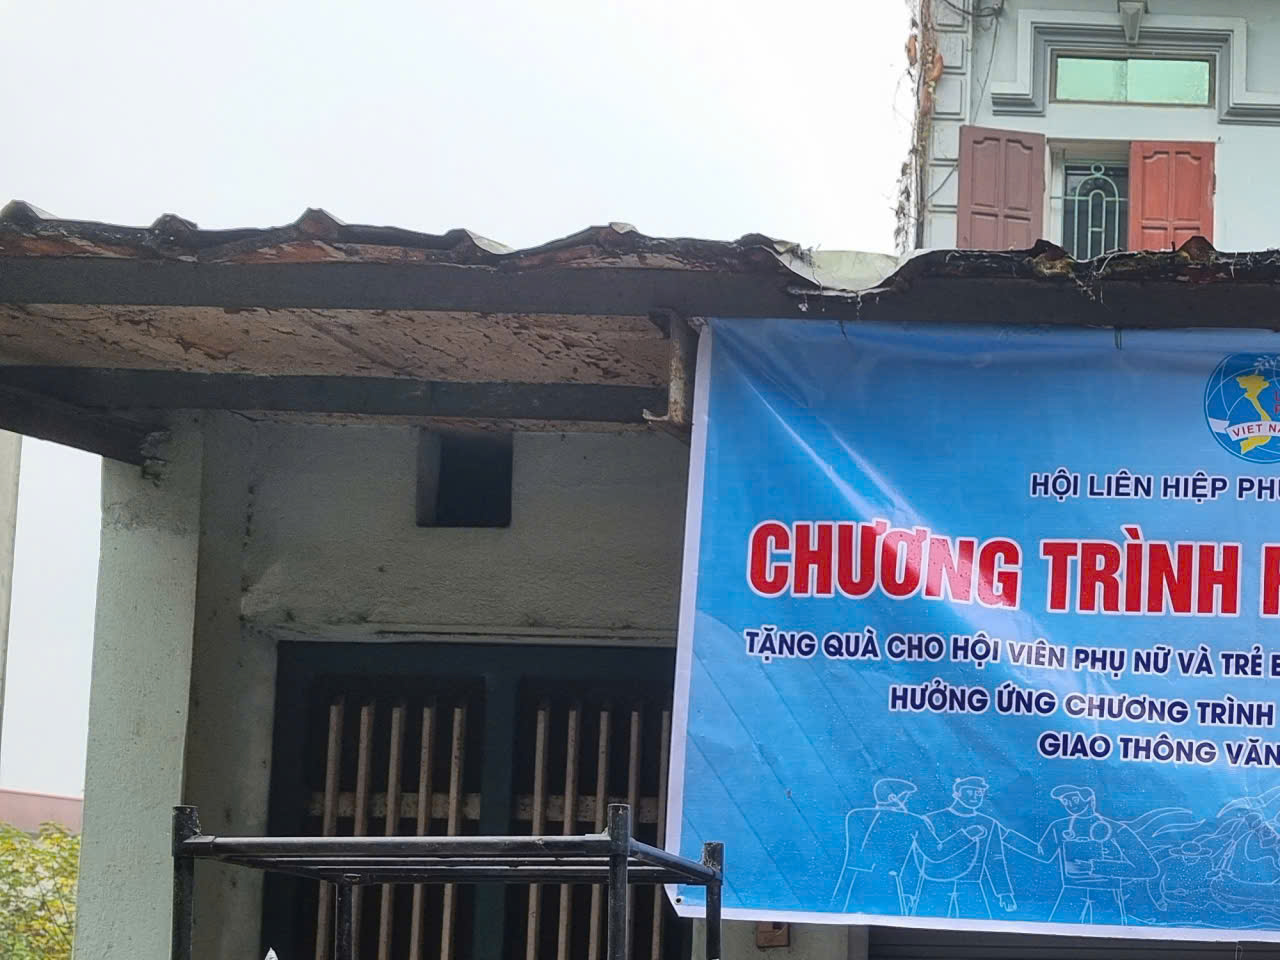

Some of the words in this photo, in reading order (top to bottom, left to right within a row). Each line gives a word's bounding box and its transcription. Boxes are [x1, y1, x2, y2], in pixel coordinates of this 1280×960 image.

[1232, 424, 1263, 437] VIET
[1032, 470, 1078, 499] HỘI
[1090, 471, 1151, 496] LIÊN
[1163, 472, 1227, 502] HIỆP
[750, 522, 1019, 606] CHƯƠNG
[1044, 528, 1239, 614] TRÌNH
[747, 628, 815, 660] TẶNG
[824, 630, 878, 657] QUÀ
[888, 636, 943, 659] CHO
[953, 634, 998, 666] HỘI
[1010, 639, 1065, 667] VIÊN
[1075, 649, 1124, 677] PHỤ
[1135, 647, 1170, 673] NỮ
[1178, 647, 1212, 674] VÀ
[1222, 647, 1262, 675] TRẺ
[892, 680, 988, 711] HƯỞNG
[998, 684, 1055, 713] ỨNG
[1066, 696, 1188, 722] CHƯƠNG
[1198, 697, 1273, 725] TRÌNH
[1040, 733, 1110, 757] GIAO
[1120, 735, 1215, 762] THÔNG
